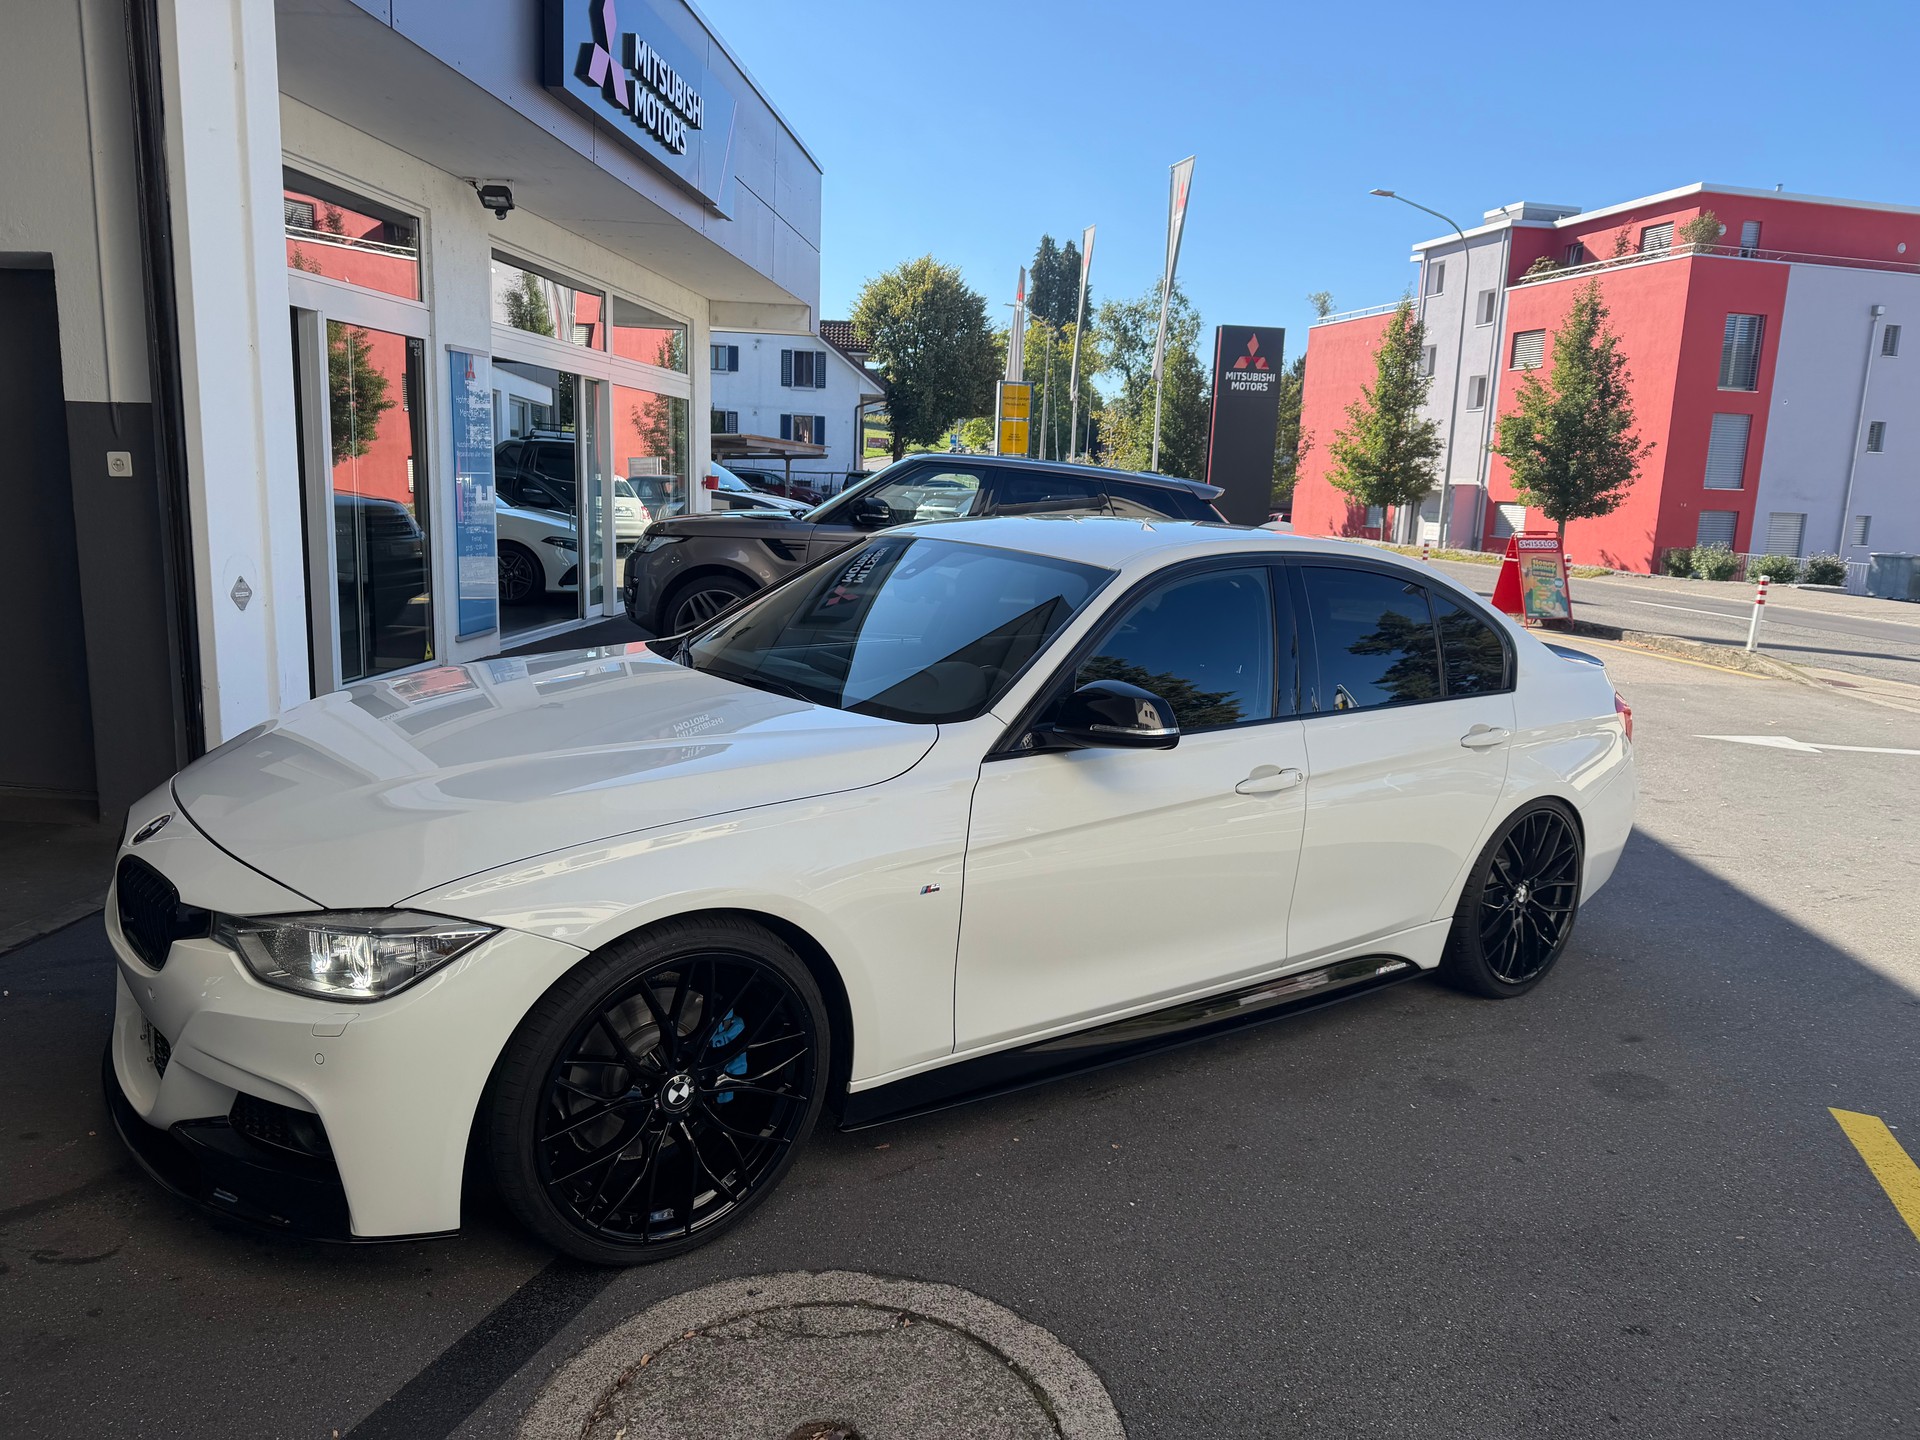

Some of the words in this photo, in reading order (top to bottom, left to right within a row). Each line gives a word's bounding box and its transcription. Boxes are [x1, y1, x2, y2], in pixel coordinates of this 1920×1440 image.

[634, 33, 704, 130] MITSUBISHI
[634, 82, 687, 156] MOTORS
[1225, 371, 1276, 382] MITSUBISHI
[1231, 381, 1269, 392] MOTORS
[1519, 540, 1558, 548] SWISSLOS
